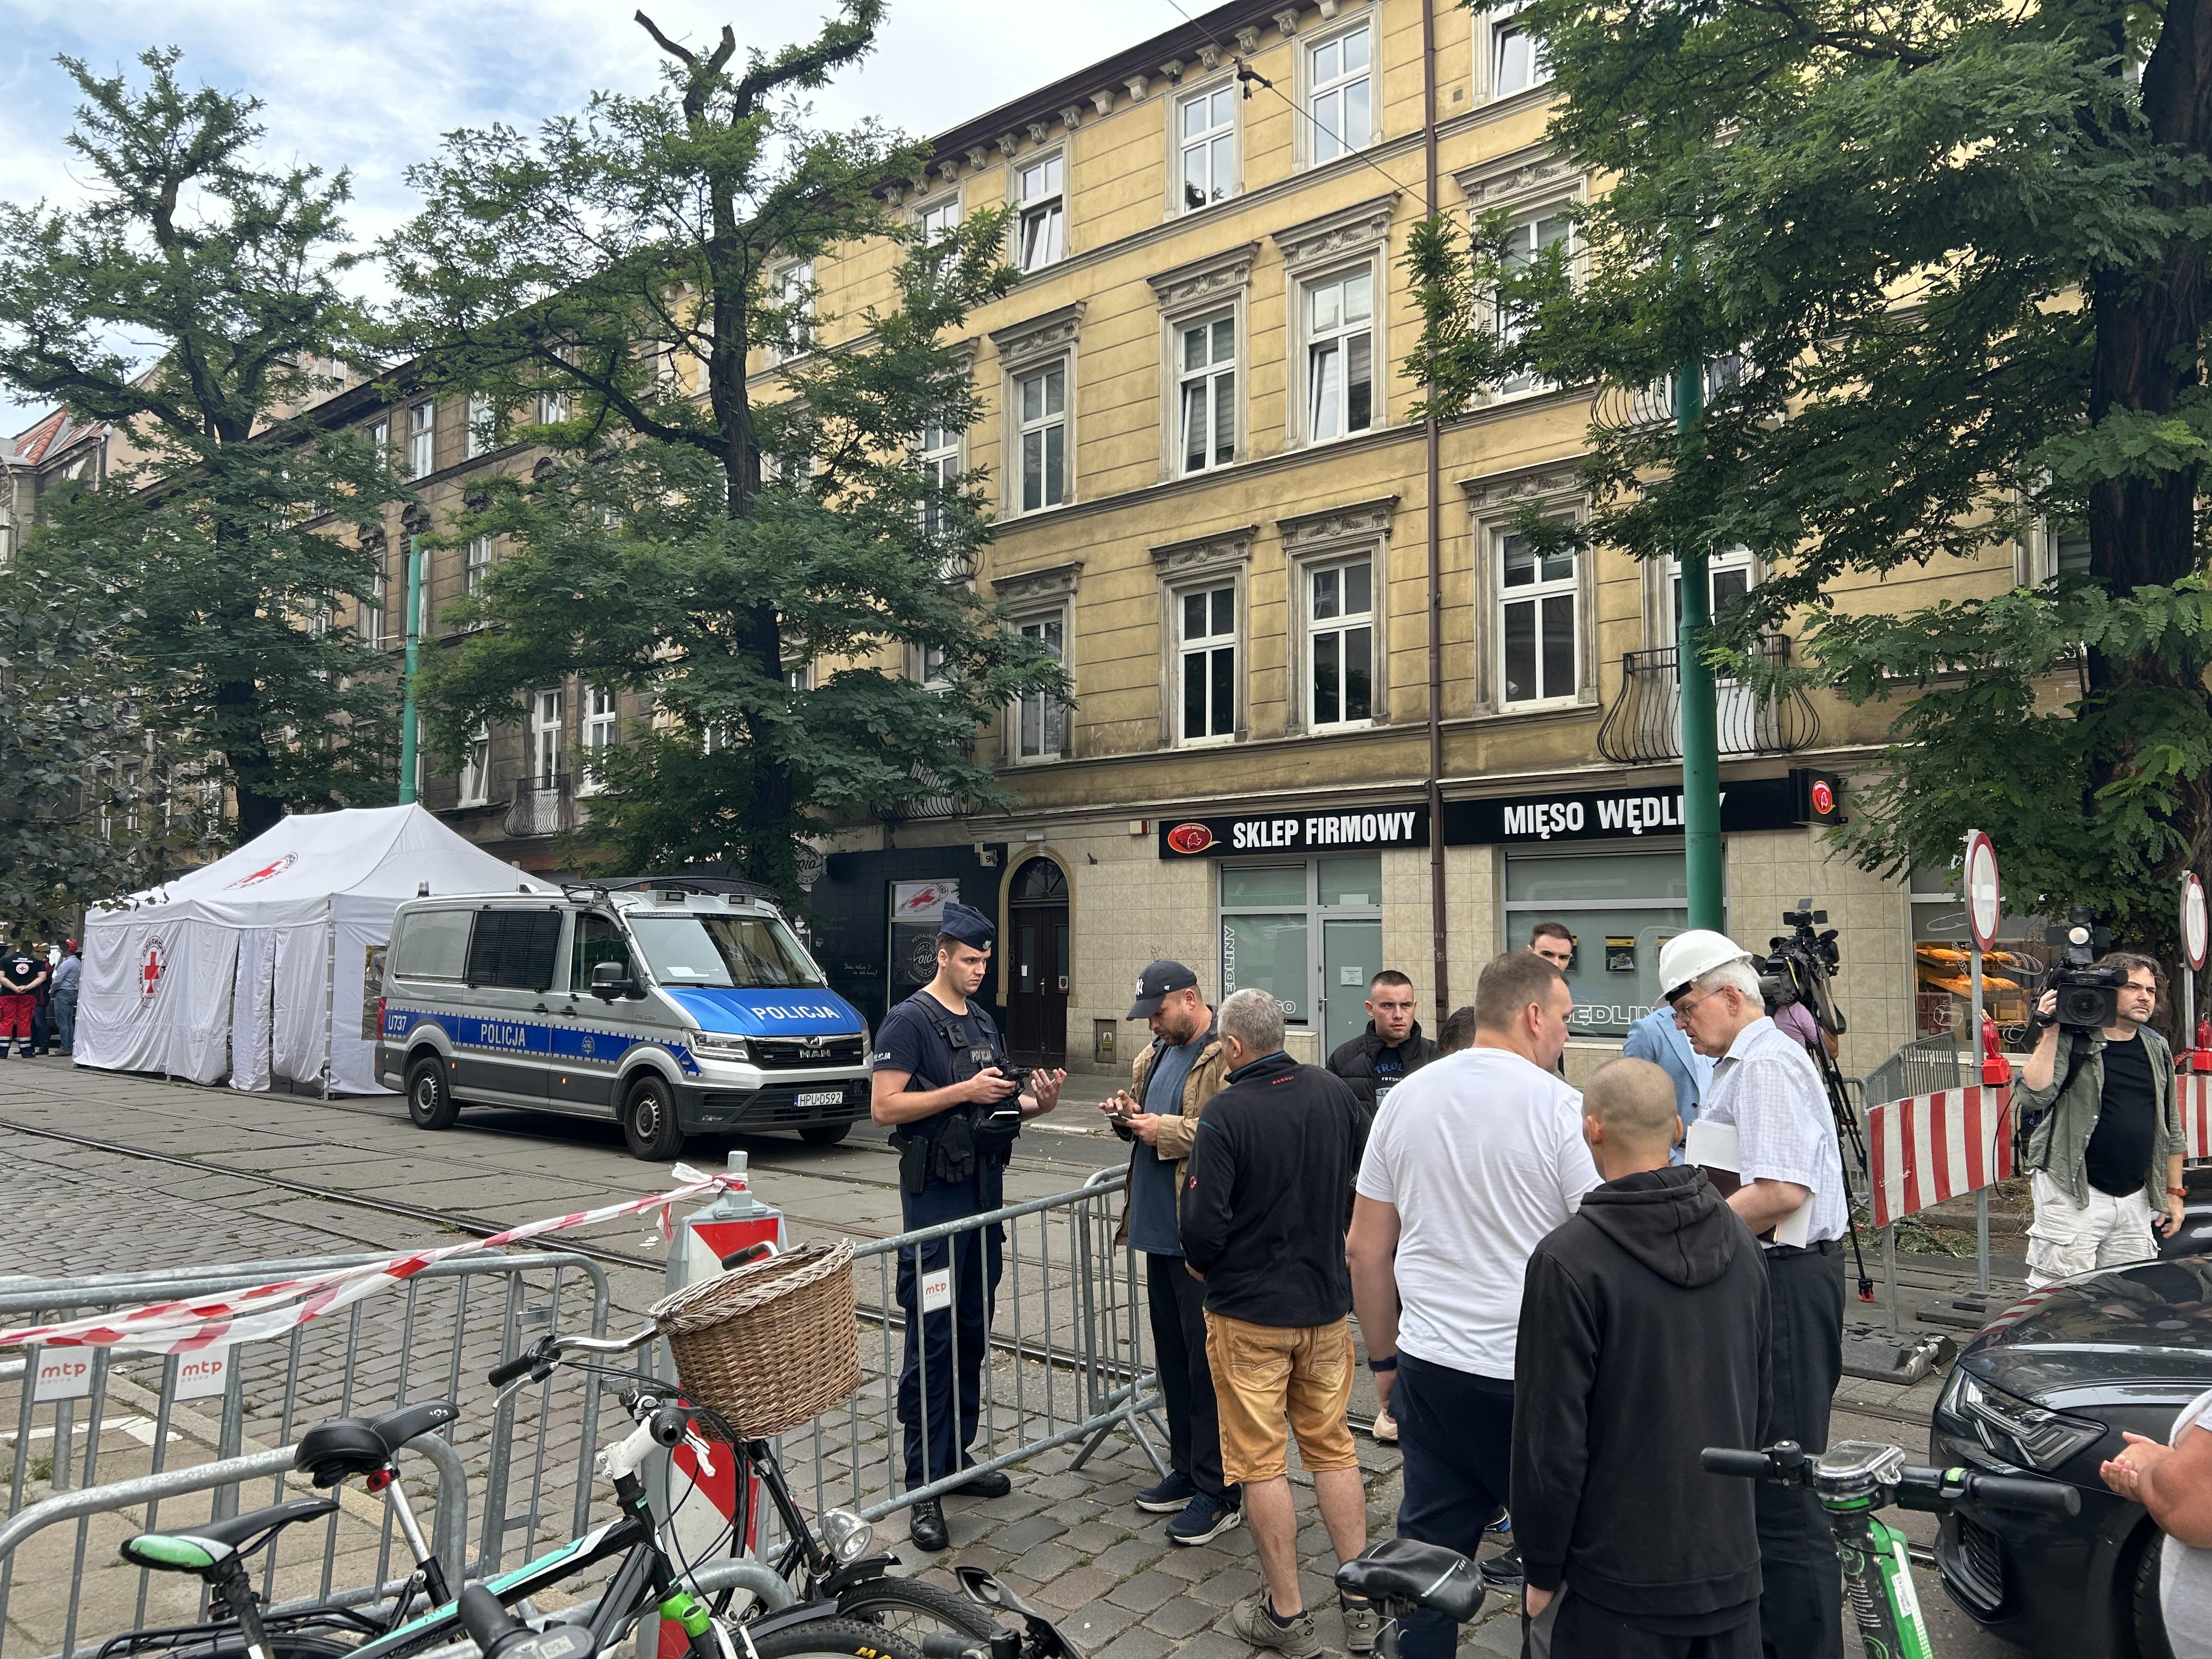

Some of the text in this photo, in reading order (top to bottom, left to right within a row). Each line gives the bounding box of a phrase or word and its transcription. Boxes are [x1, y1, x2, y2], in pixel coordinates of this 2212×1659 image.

[1504, 792, 1726, 839] MIĘSO WĘDLI
[1233, 812, 1416, 849] SKLEP FIRMOWY
[911, 933, 937, 943] RESTAURAN
[1224, 925, 1235, 999] ĘDLINY
[750, 1006, 840, 1020] POLICJA
[388, 1014, 407, 1031] U737
[481, 1023, 526, 1047] POLICJA
[799, 1048, 831, 1058] MAN
[972, 1050, 992, 1062] POLICJA
[800, 1093, 840, 1105] HPU D592
[926, 1283, 946, 1295] mtp
[41, 1363, 86, 1378] mtp
[182, 1361, 223, 1376] mtp
